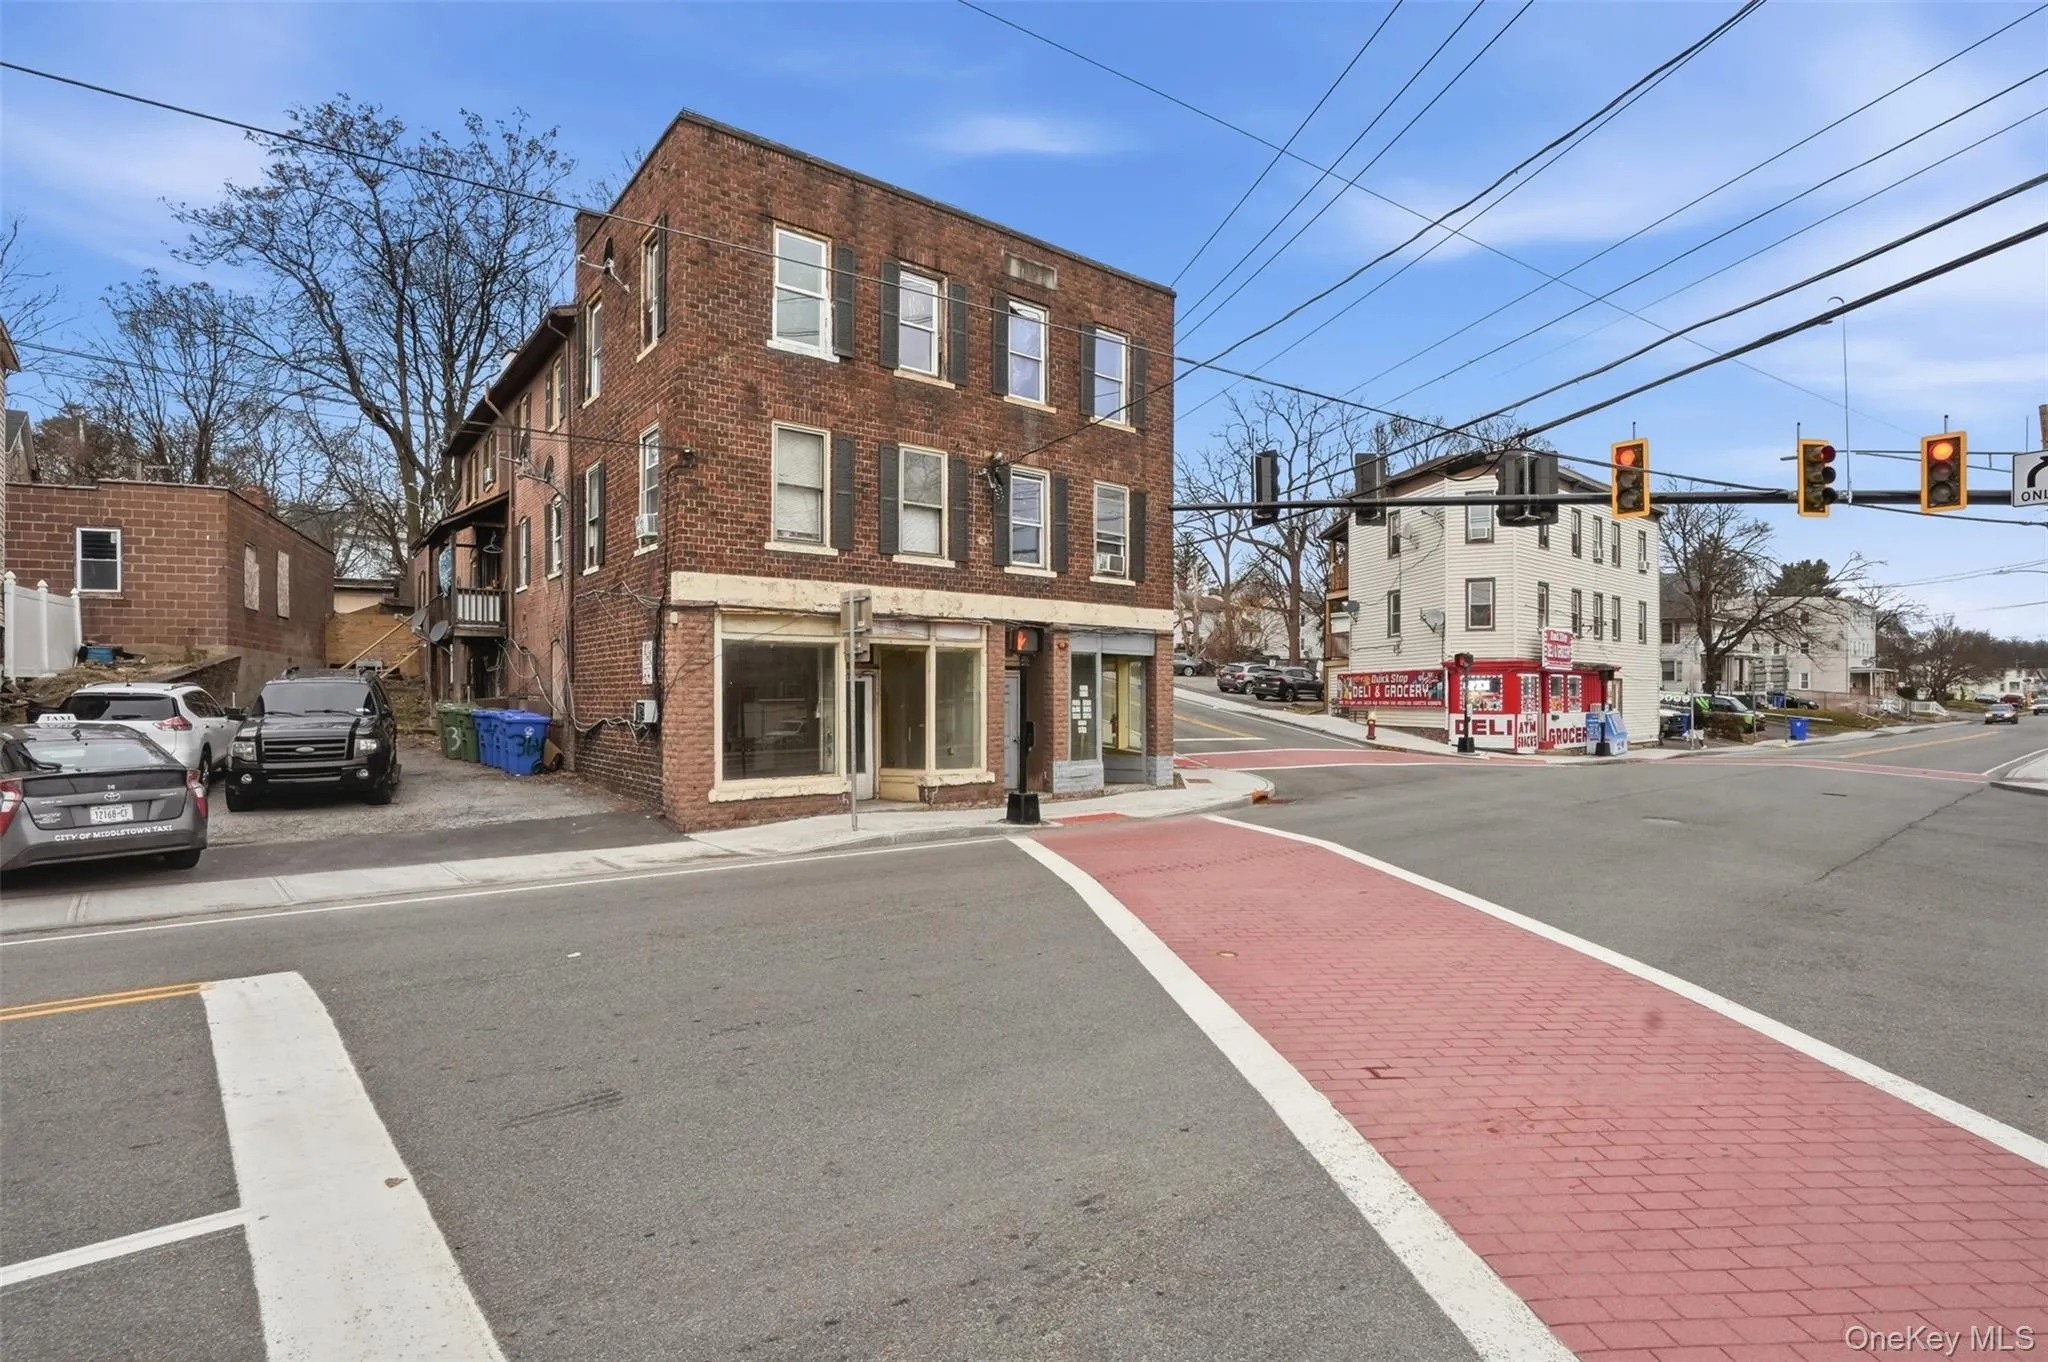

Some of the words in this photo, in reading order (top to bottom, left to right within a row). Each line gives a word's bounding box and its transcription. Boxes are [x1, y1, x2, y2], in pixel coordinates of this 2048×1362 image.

[1371, 674, 1389, 684] Quick
[1391, 673, 1409, 684] Stop
[1352, 685, 1371, 698] DELI
[1375, 684, 1380, 698] &
[1384, 683, 1429, 698] GROCERY
[1455, 719, 1512, 735] DELI
[54, 833, 77, 841] CITY
[93, 827, 150, 838] MIDDLETOWN
